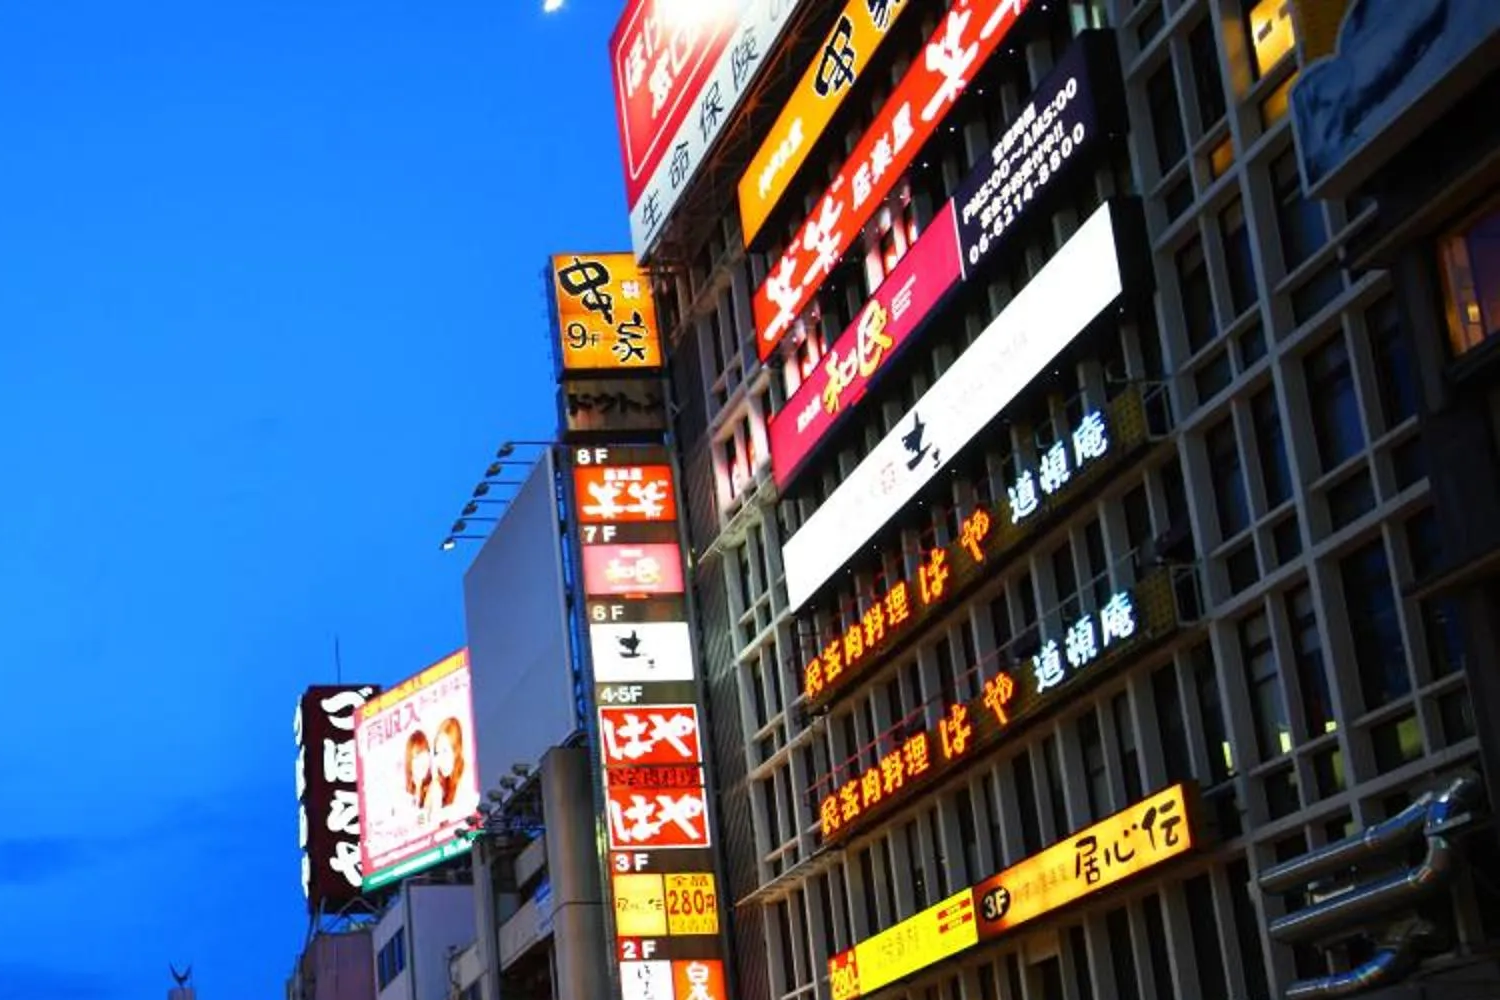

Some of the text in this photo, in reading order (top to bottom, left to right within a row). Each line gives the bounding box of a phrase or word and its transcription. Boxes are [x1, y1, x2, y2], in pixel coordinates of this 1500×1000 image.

[603, 713, 695, 760] はや
[610, 794, 704, 842] はや
[615, 853, 649, 871] 3F
[622, 940, 656, 959] 2F
